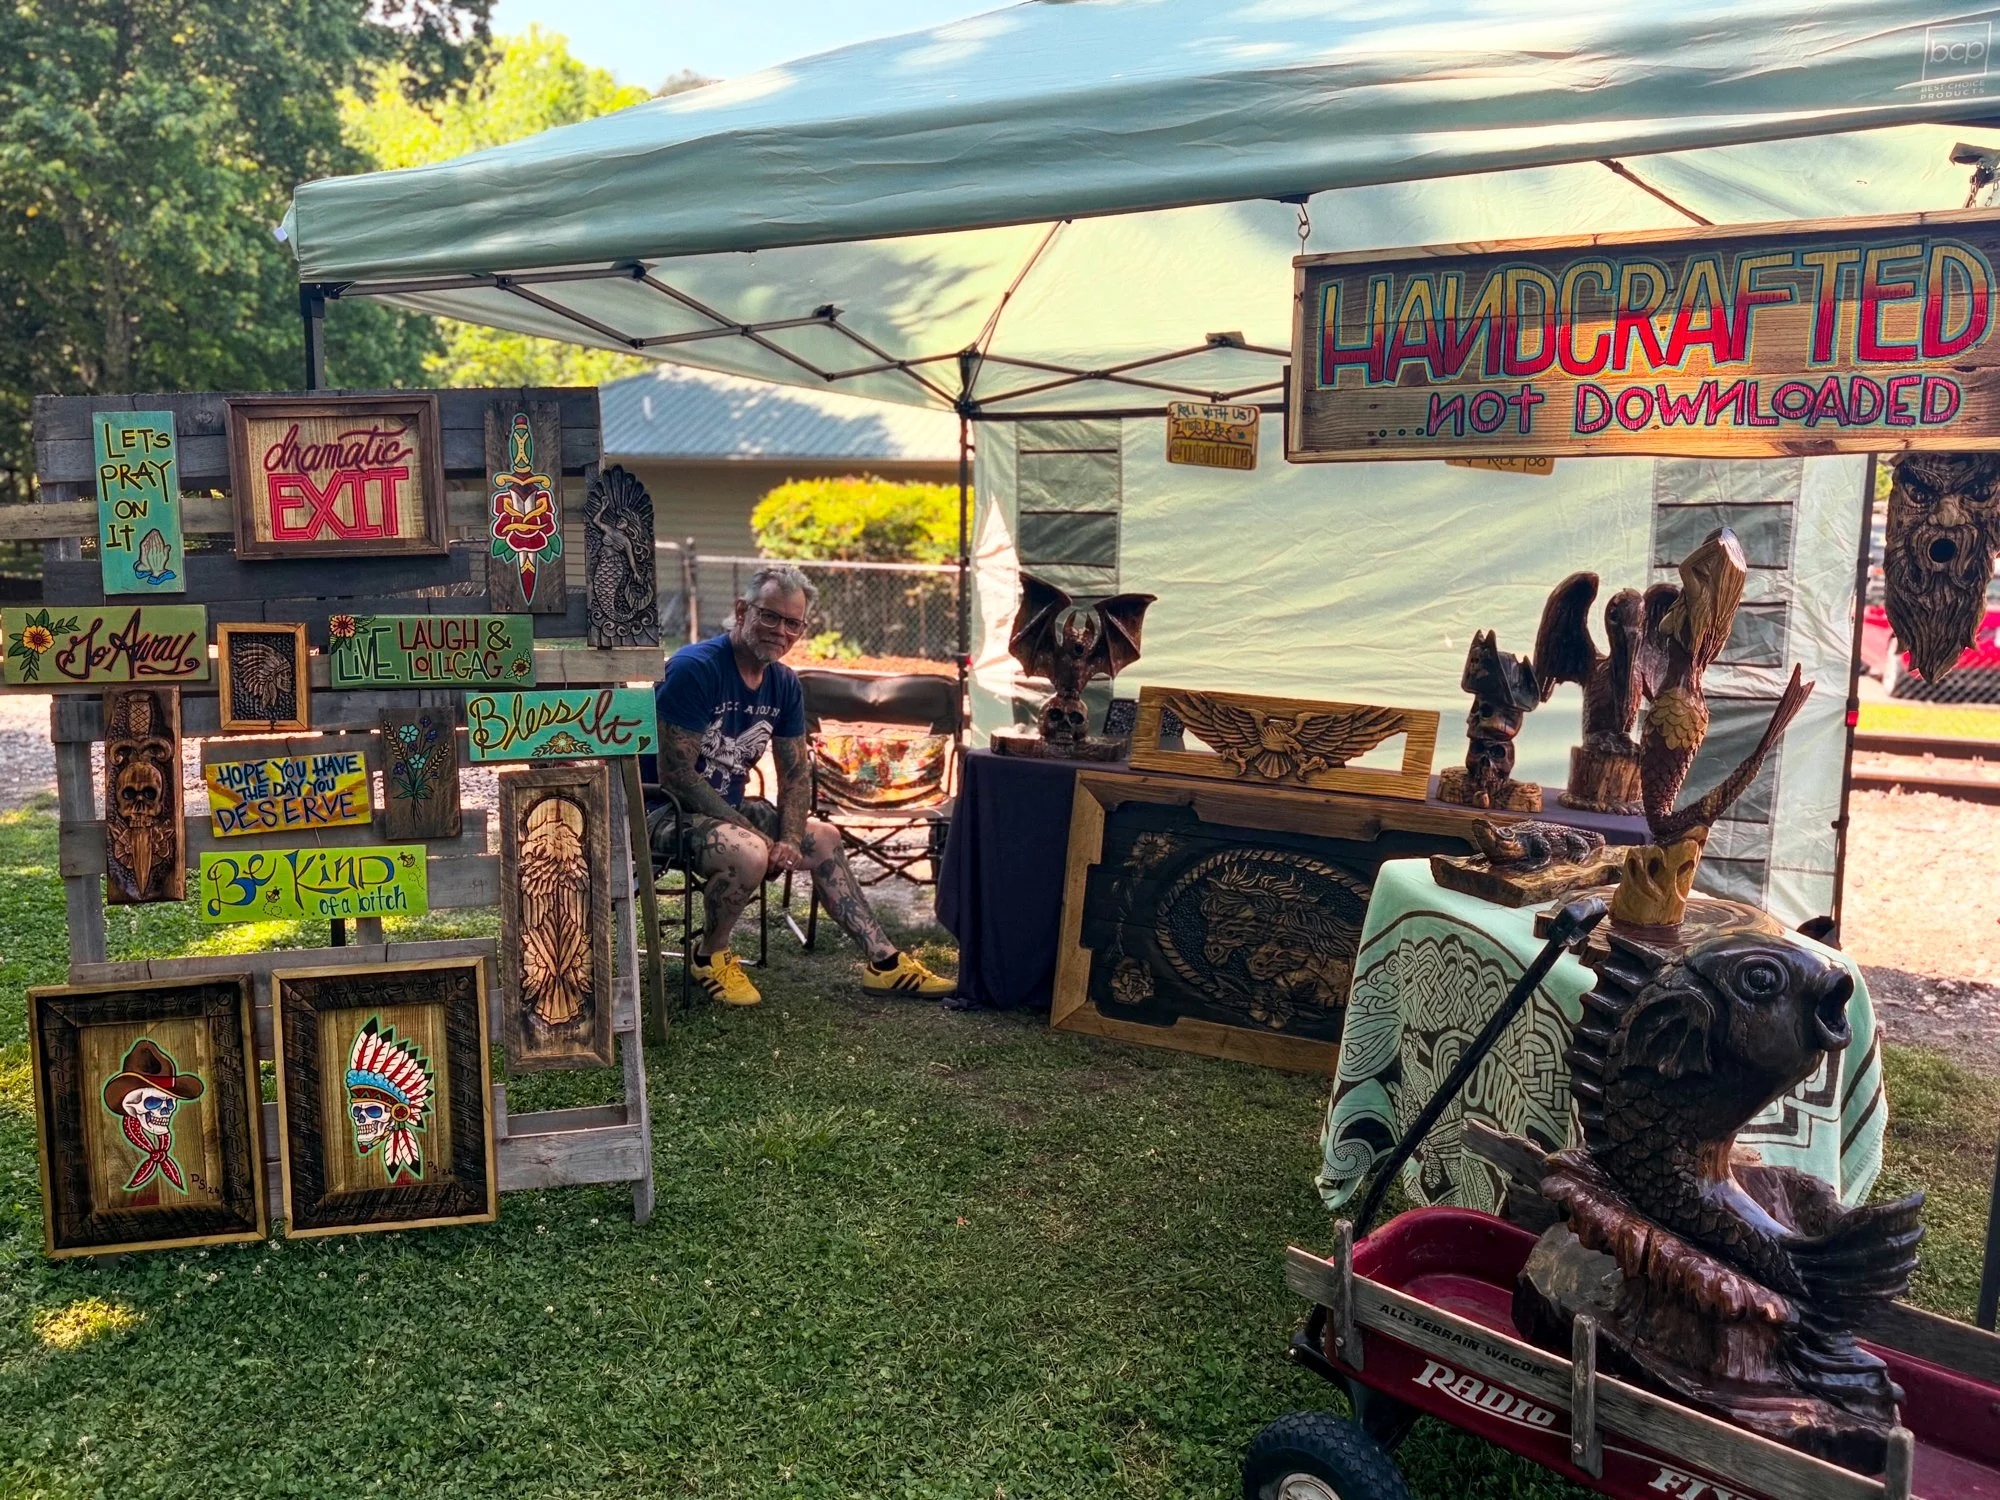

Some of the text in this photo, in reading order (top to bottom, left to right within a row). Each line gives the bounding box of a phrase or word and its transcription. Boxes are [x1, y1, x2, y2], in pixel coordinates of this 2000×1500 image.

[1930, 39, 1985, 64] bcp
[1920, 89, 1985, 100] PRODUCTS
[1921, 80, 1985, 93] BEST CHOICE
[1318, 240, 1994, 388] HANDCRAFTED
[1573, 374, 1962, 434] DOWNLOADED
[263, 423, 414, 475] dramatic
[100, 460, 173, 503] PRAY
[114, 500, 149, 520] ON
[267, 466, 409, 541] EXIT
[55, 607, 201, 681] Go Away
[398, 618, 513, 651] LAUGH &
[468, 689, 643, 759] Bless It
[216, 754, 362, 790] HOPE YOU HAVE
[236, 778, 336, 801] THE DAY YOU
[215, 792, 357, 834] DESERVE
[341, 898, 352, 914] a
[357, 884, 408, 913] bitch
[1379, 1303, 1546, 1377] ALL-TERRAIN WAGON
[1411, 1358, 1557, 1429] RADIO
